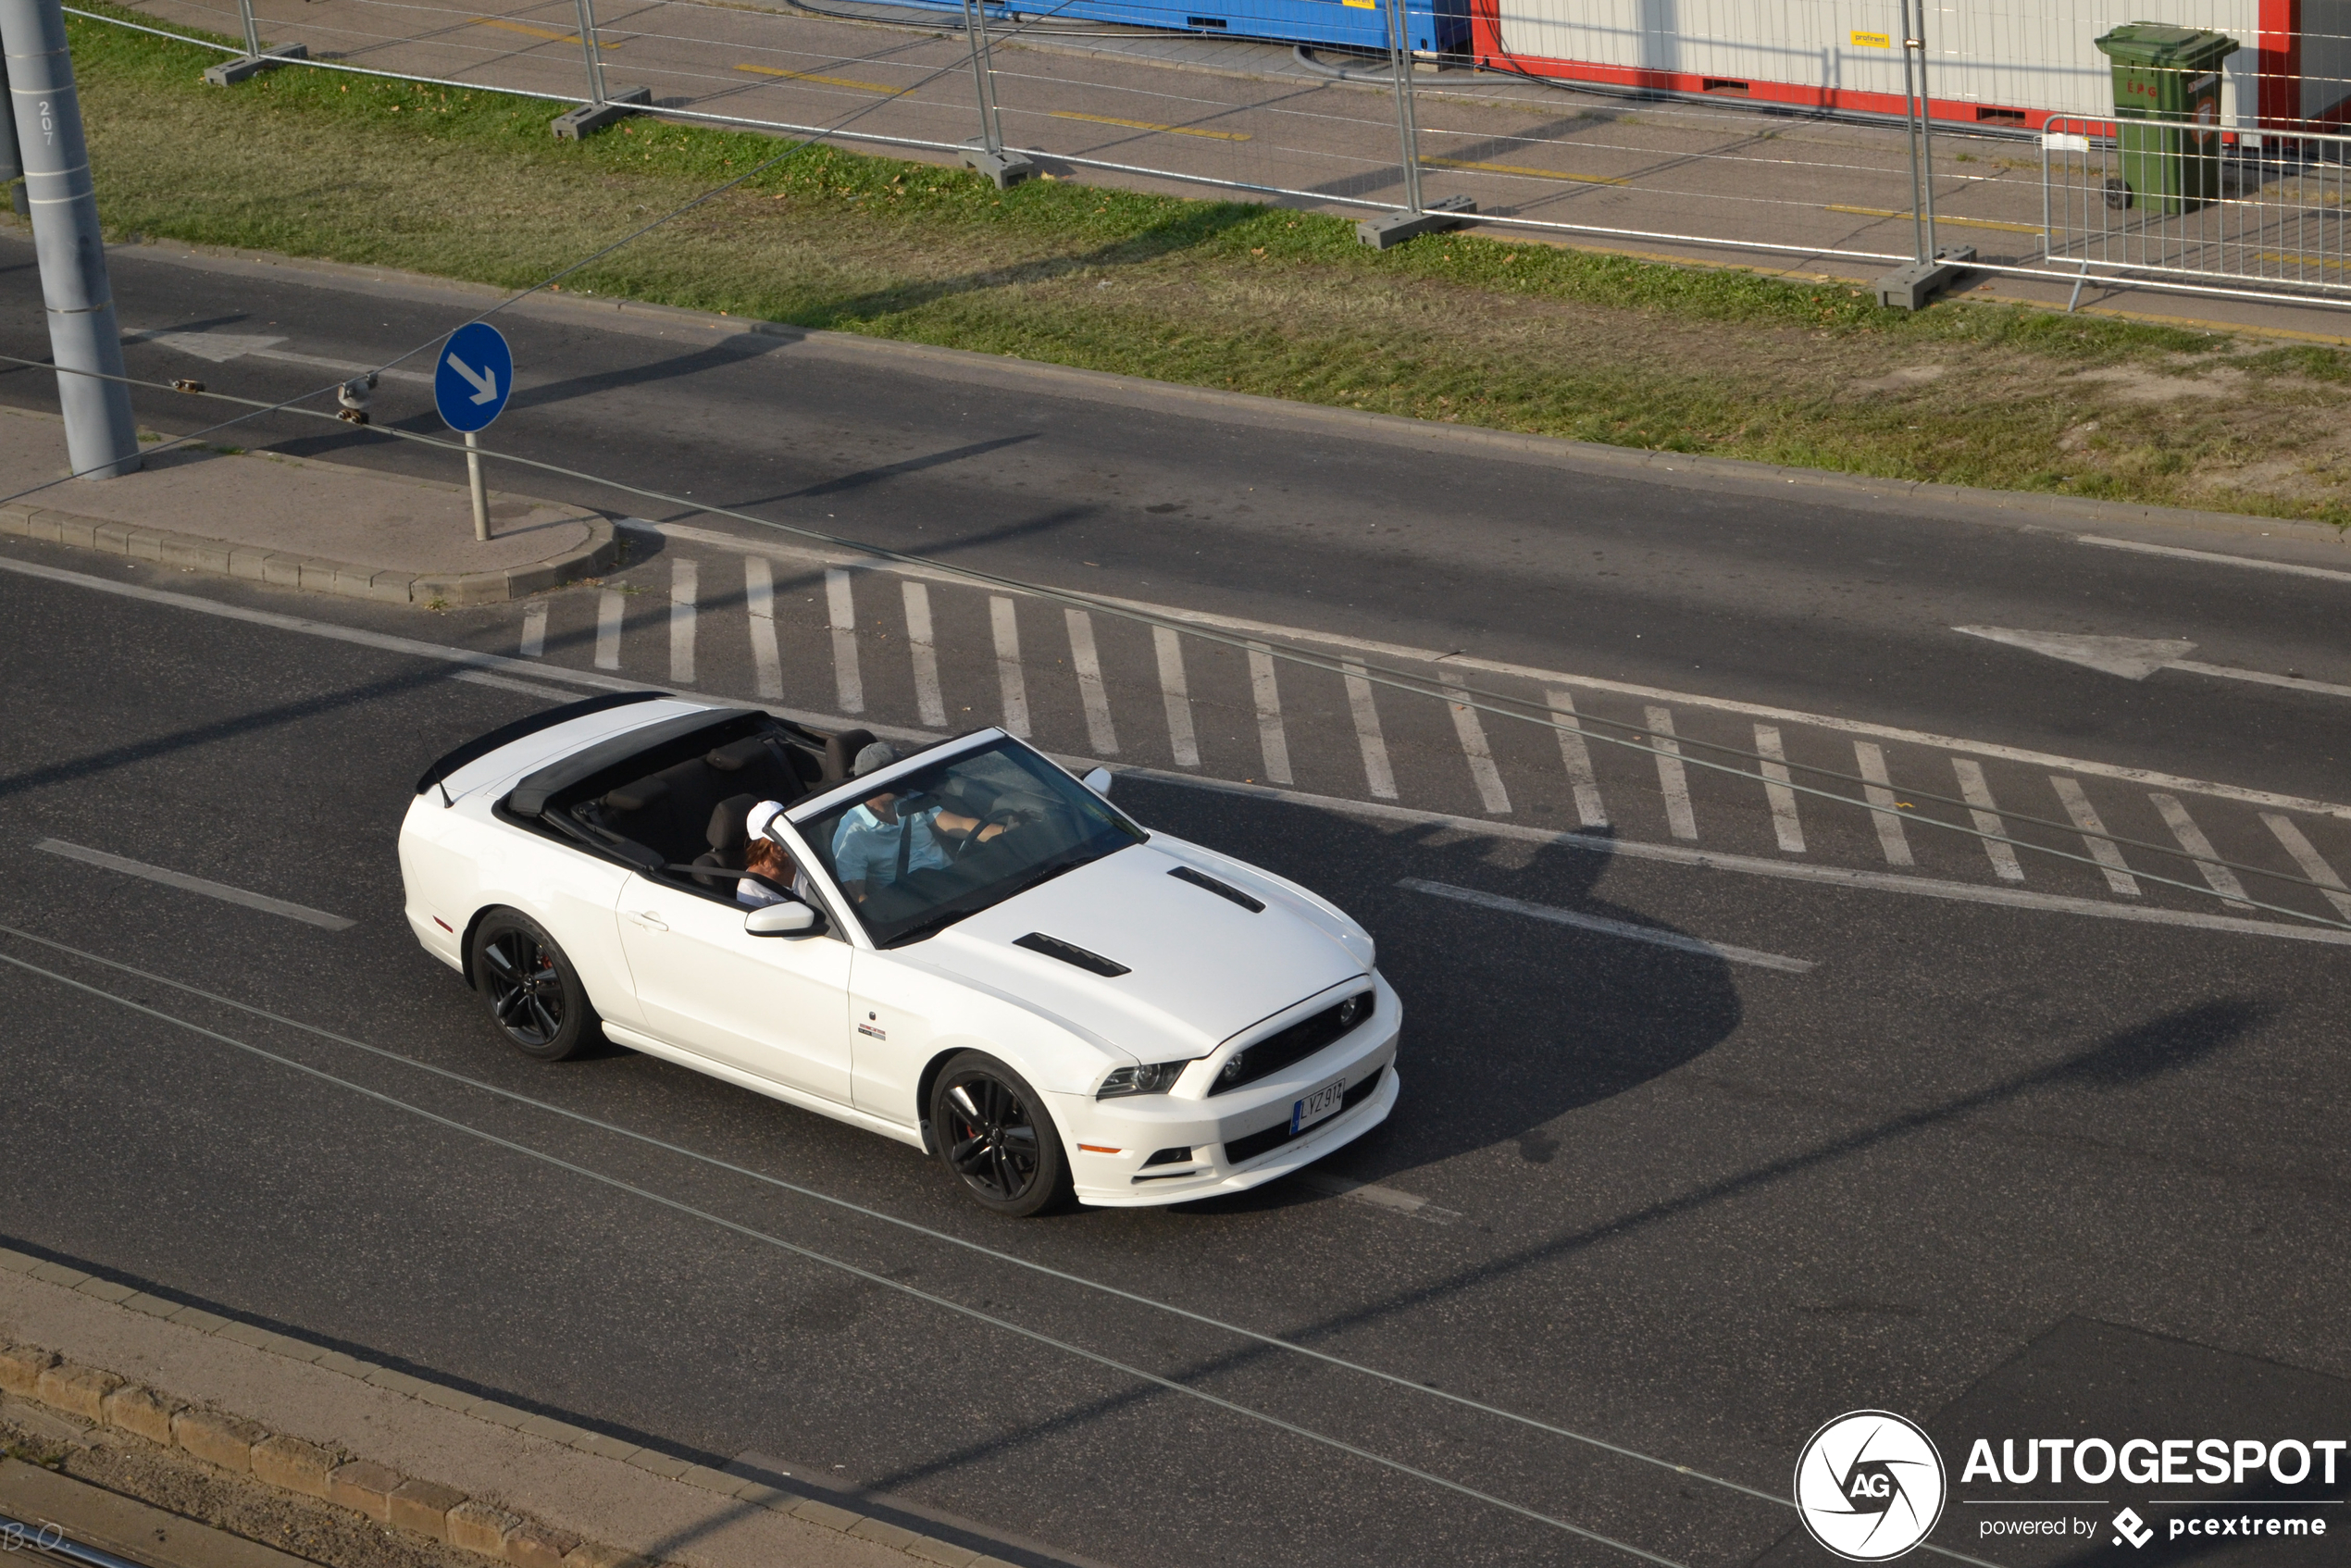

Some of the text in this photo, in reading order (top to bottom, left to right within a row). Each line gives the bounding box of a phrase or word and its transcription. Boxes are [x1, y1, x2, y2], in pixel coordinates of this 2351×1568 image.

[1855, 34, 1885, 44] profirent
[38, 101, 54, 146] 207
[1300, 1082, 1342, 1120] LYZ 914
